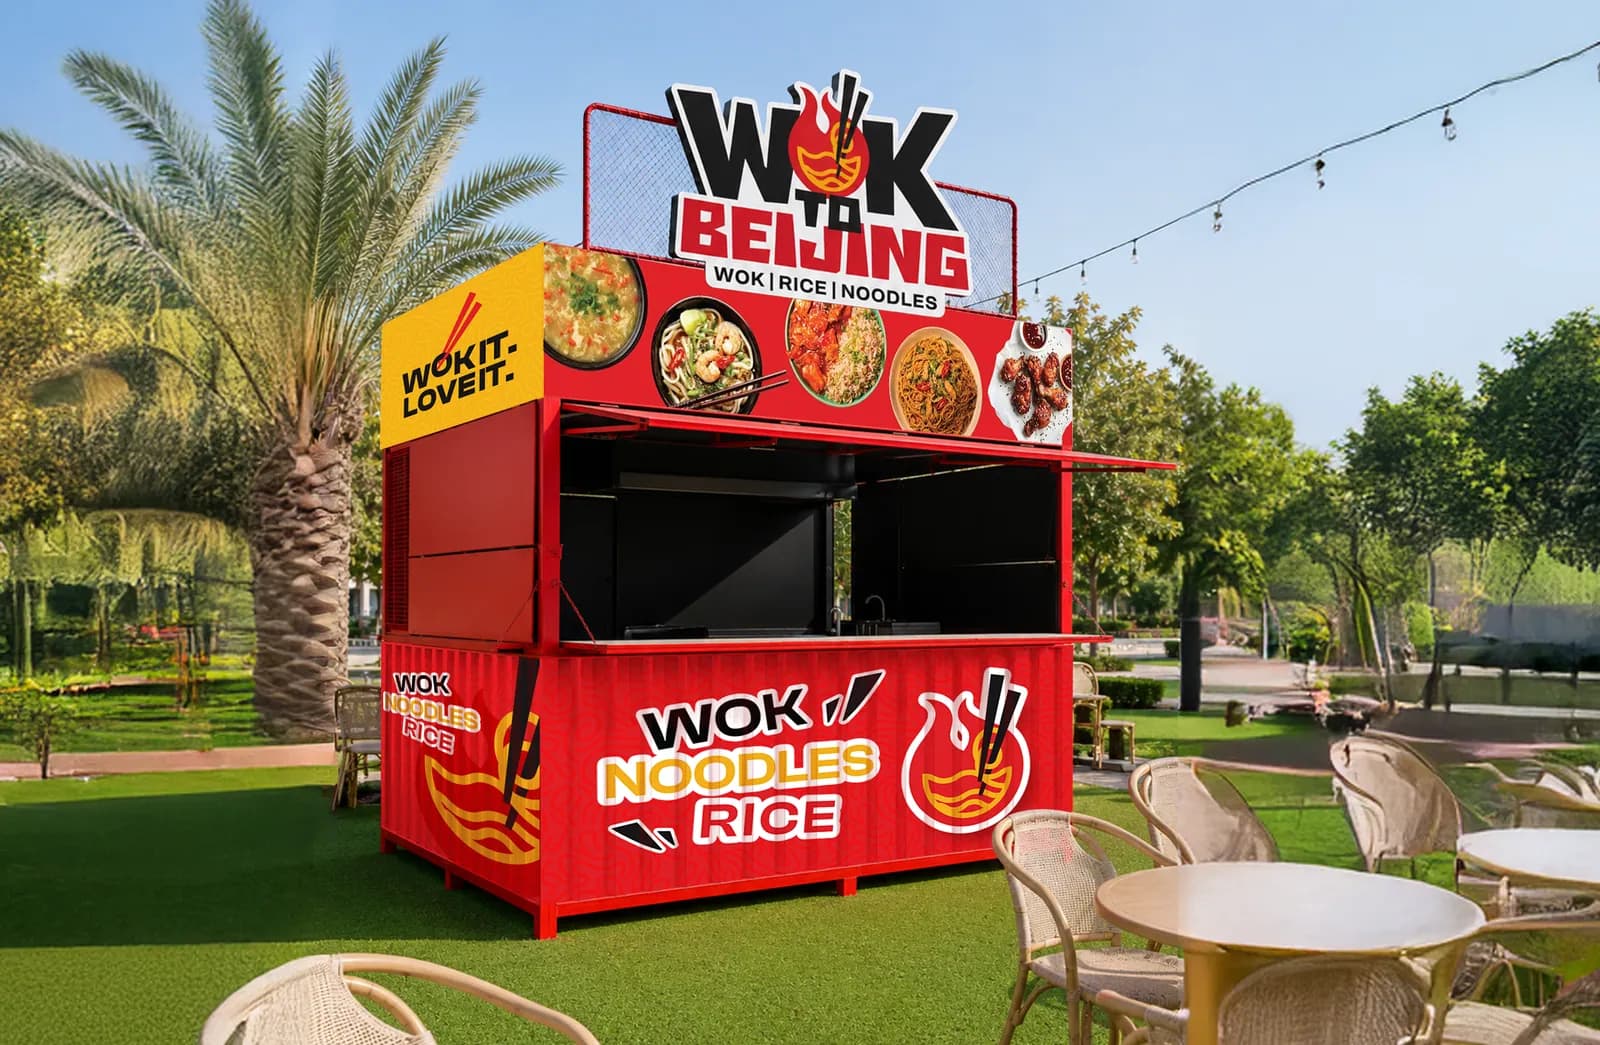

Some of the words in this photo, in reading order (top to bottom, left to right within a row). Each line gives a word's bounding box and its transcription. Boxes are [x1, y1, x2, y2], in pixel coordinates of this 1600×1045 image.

[795, 188, 862, 234] TO
[680, 197, 970, 292] BEIJING
[714, 265, 765, 288] WOK
[778, 275, 827, 296] RICE
[841, 284, 938, 310] NOODLES
[402, 343, 476, 395] WOK
[479, 329, 517, 365] IT.
[403, 371, 476, 419] LOVE
[478, 359, 515, 392] IT.
[393, 672, 451, 696] WOK
[384, 692, 480, 732] NOODLES
[641, 687, 808, 751] WOK
[403, 718, 454, 754] RICE
[603, 743, 875, 800] NOODLES
[700, 800, 836, 839] RICE
